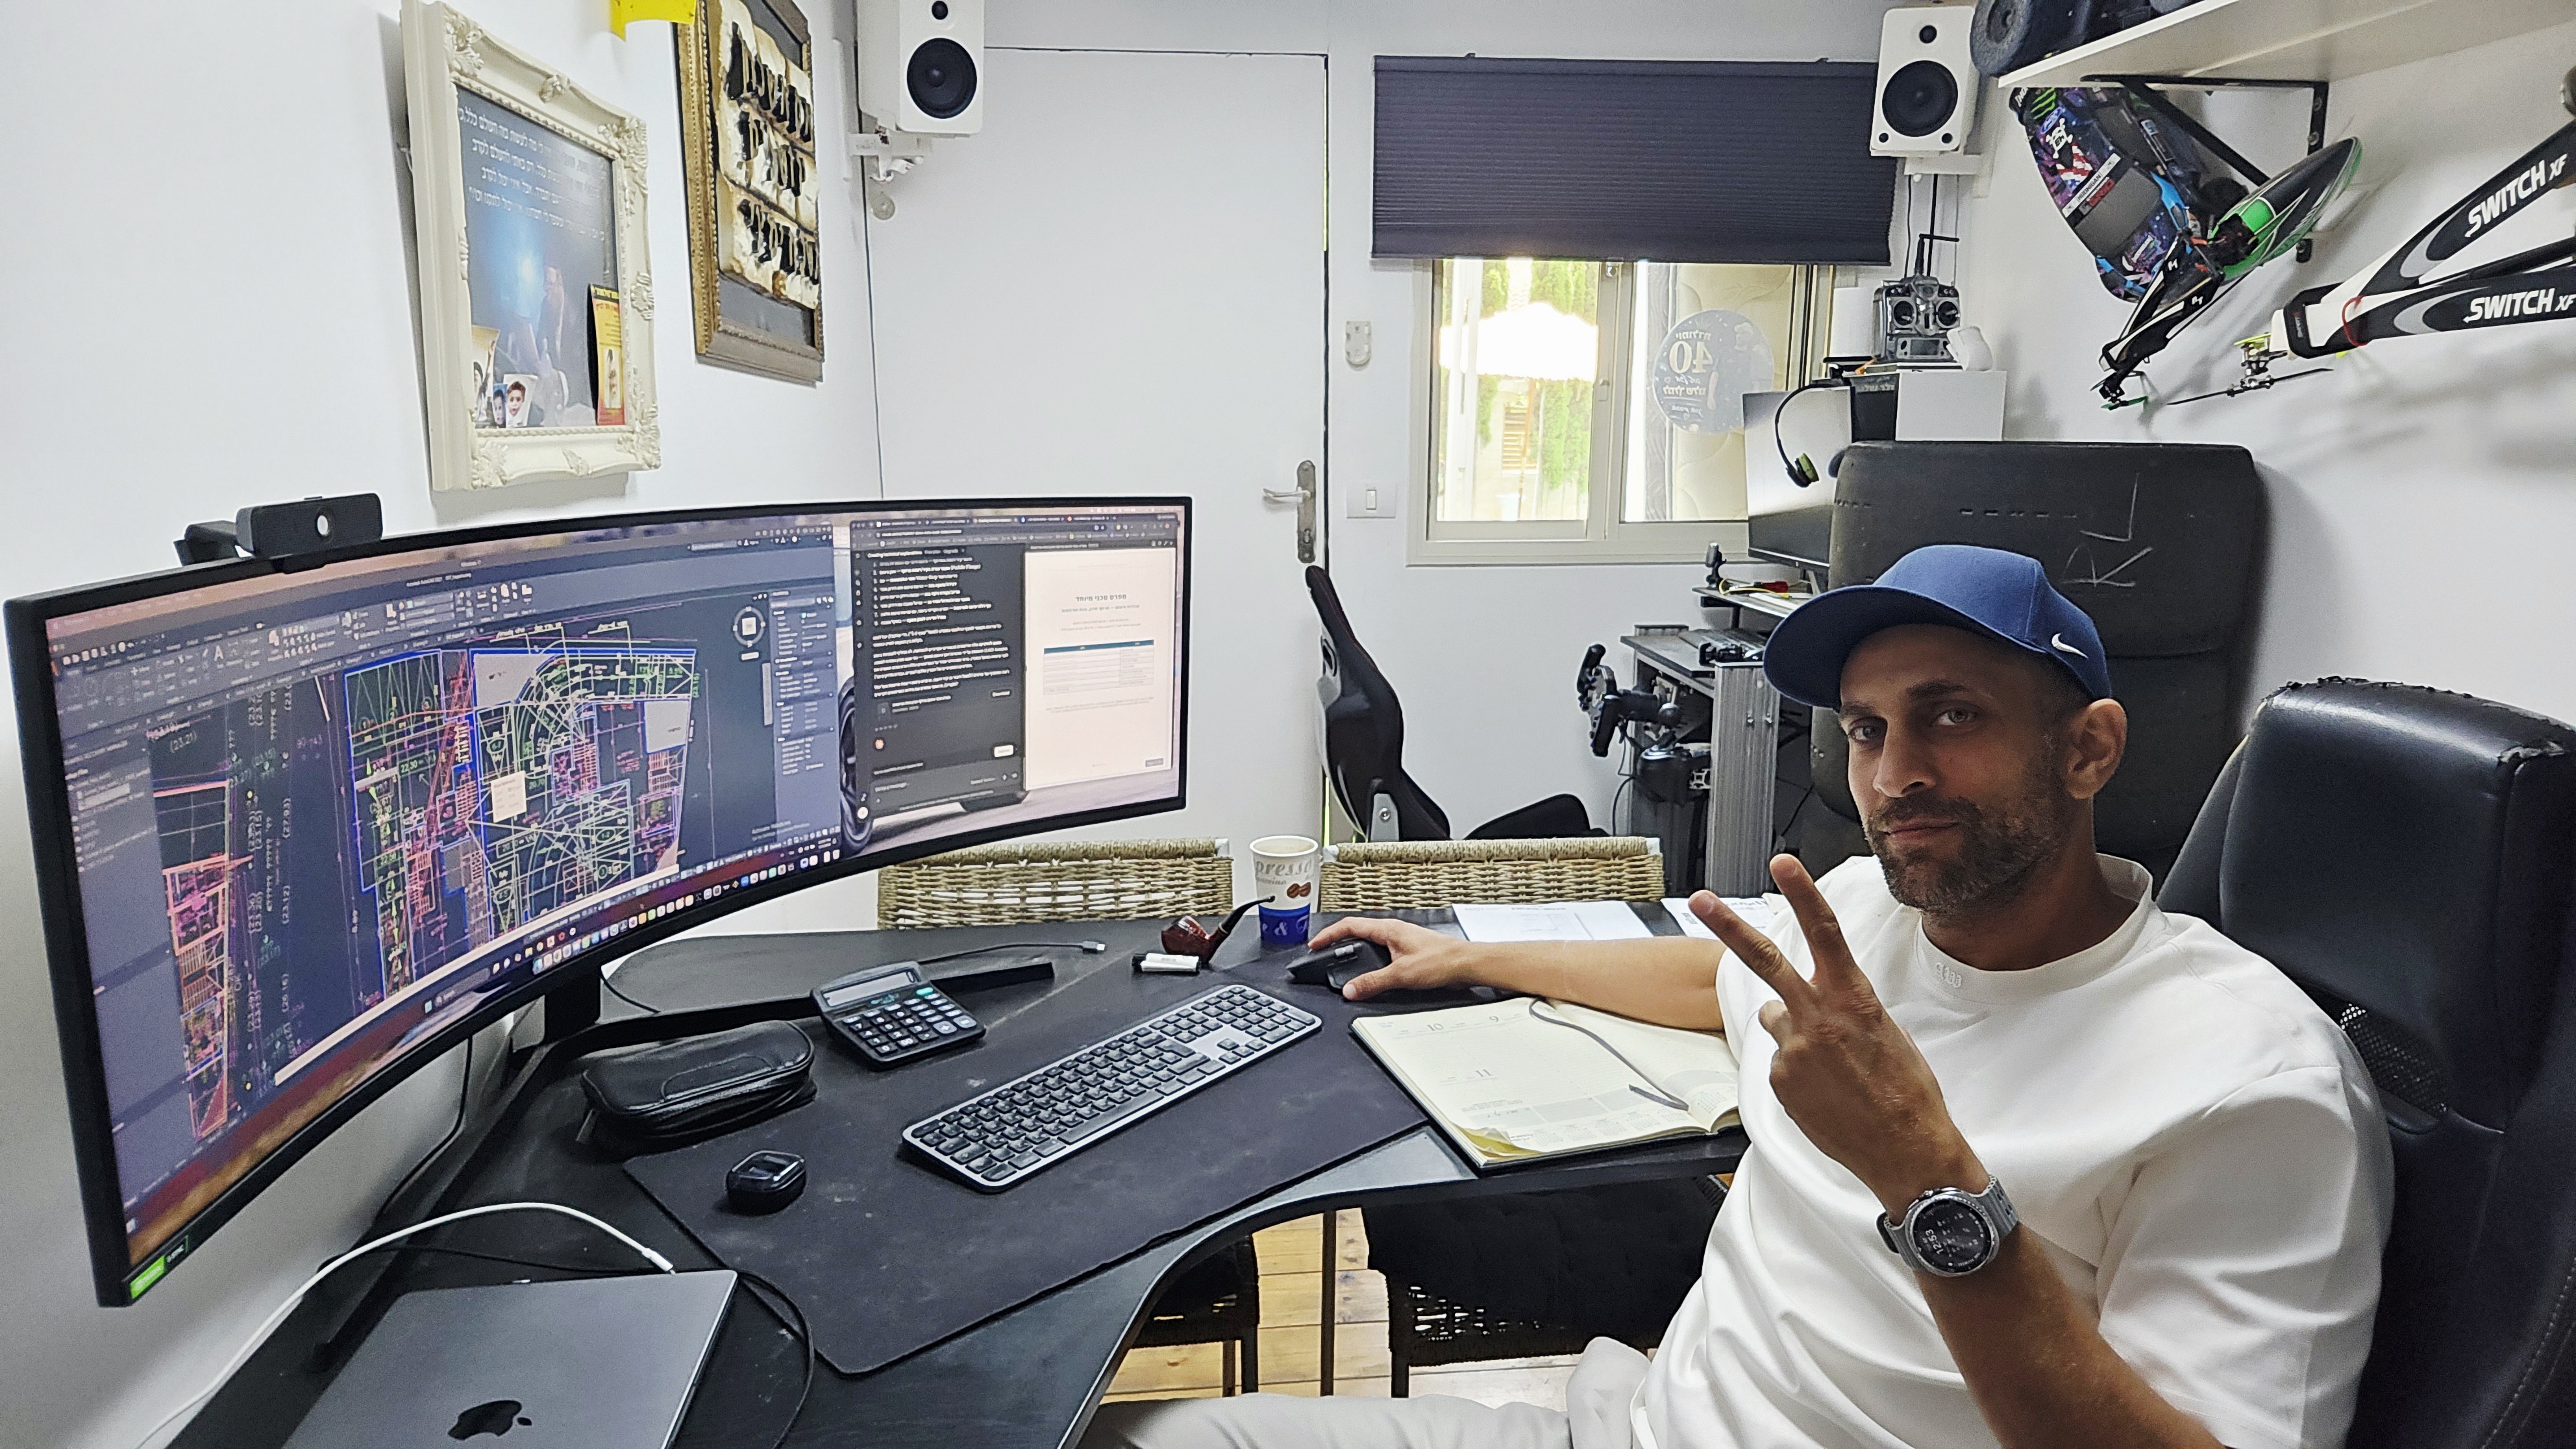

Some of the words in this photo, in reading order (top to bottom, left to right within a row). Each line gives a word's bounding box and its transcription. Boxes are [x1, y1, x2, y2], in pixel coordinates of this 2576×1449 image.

[2464, 160, 2546, 237] SWITCH
[2549, 153, 2568, 181] XF
[2462, 288, 2555, 323] SWITCH
[2555, 294, 2576, 312] XF
[1428, 1023, 1444, 1032] 10
[1476, 1069, 1492, 1078] 11
[1926, 1229, 1944, 1254] 12:53
